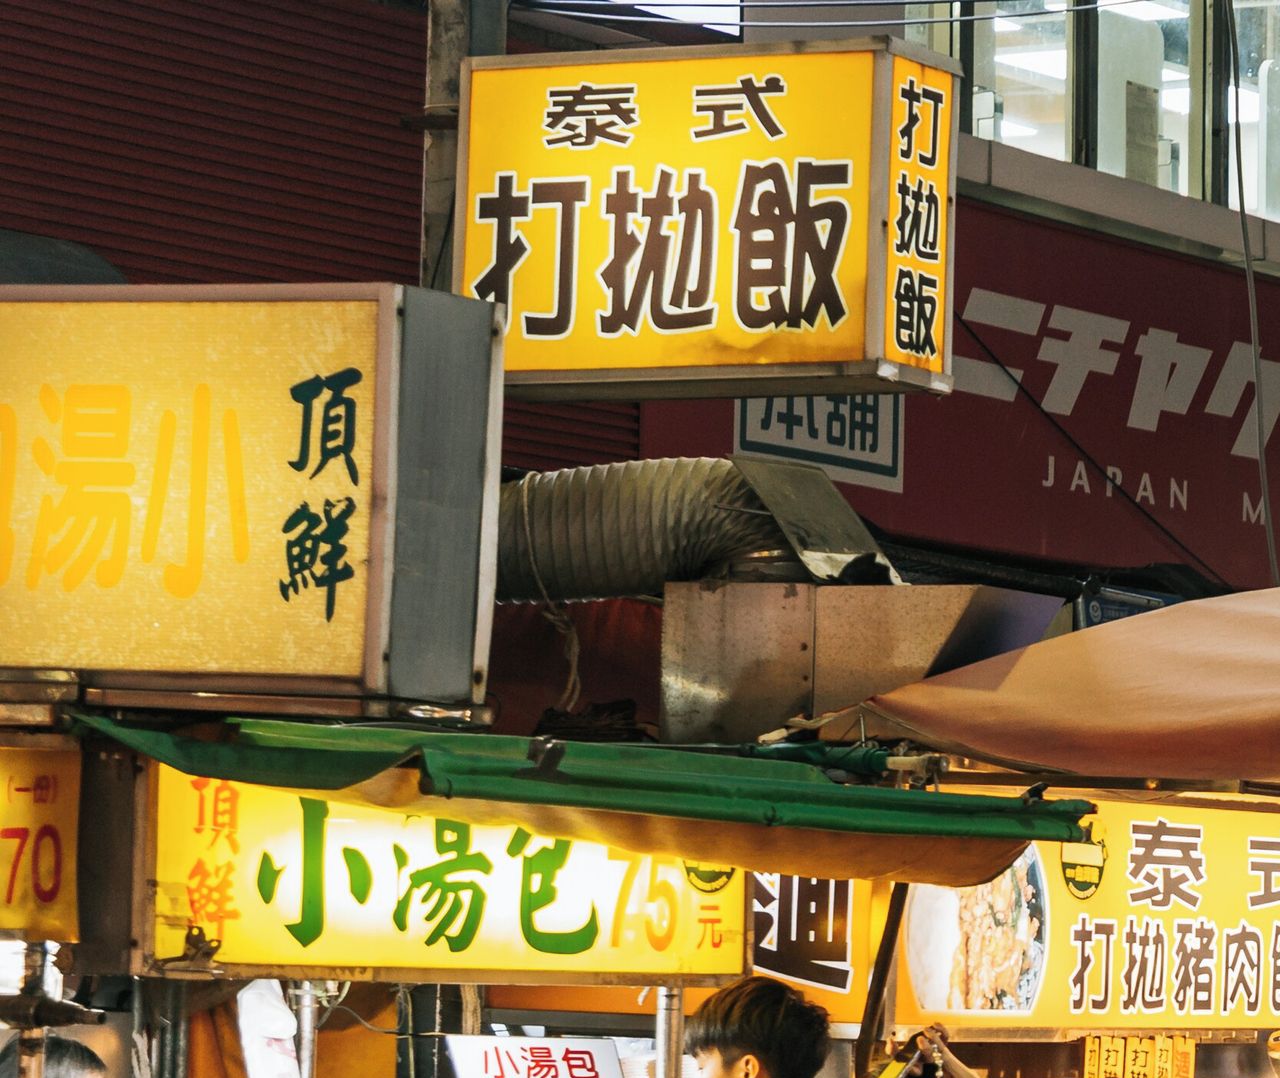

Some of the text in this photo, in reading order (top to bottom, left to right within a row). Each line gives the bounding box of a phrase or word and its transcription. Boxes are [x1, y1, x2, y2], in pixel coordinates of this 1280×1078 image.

[545, 75, 785, 149] 泰式
[280, 367, 363, 623] 頂鮮
[1043, 455, 1189, 511] JAPAN
[0, 824, 62, 905] 70
[257, 796, 598, 953] 小湯包
[697, 904, 723, 950] 元
